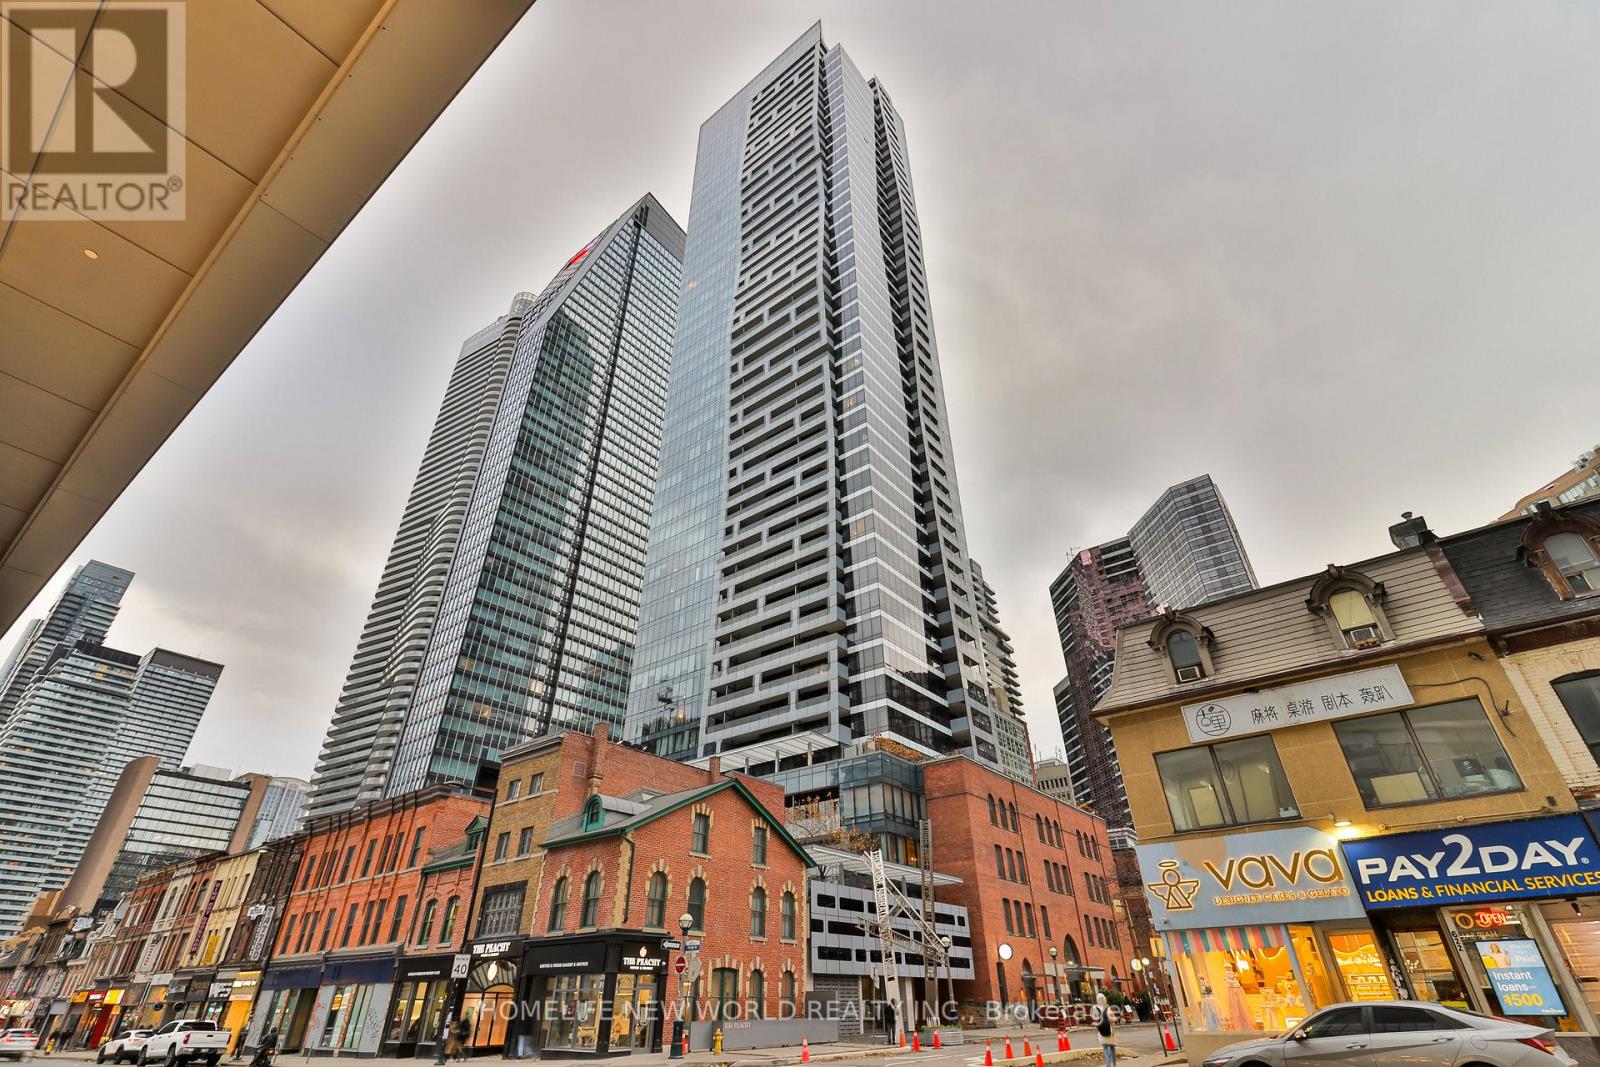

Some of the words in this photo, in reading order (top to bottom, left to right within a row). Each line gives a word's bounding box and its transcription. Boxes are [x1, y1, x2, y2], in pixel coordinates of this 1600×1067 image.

[1251, 705, 1279, 725] 麻将
[1286, 699, 1316, 719] 桌游
[1320, 691, 1354, 712] 剧本
[1203, 848, 1345, 891] vava
[1366, 887, 1419, 903] LOANS
[1421, 885, 1434, 898] &
[1435, 877, 1524, 898] FINANCIAL
[1526, 869, 1600, 890] SERVICES
[1213, 894, 1261, 905] DESIGNER
[1263, 891, 1296, 902] CAKES
[1298, 890, 1306, 900] &
[1308, 887, 1351, 899] GELATO
[1480, 912, 1507, 925] OPEN
[1451, 930, 1464, 952] 622
[453, 964, 467, 975] 40
[1492, 970, 1533, 980] Instant
[1496, 981, 1530, 992] loans
